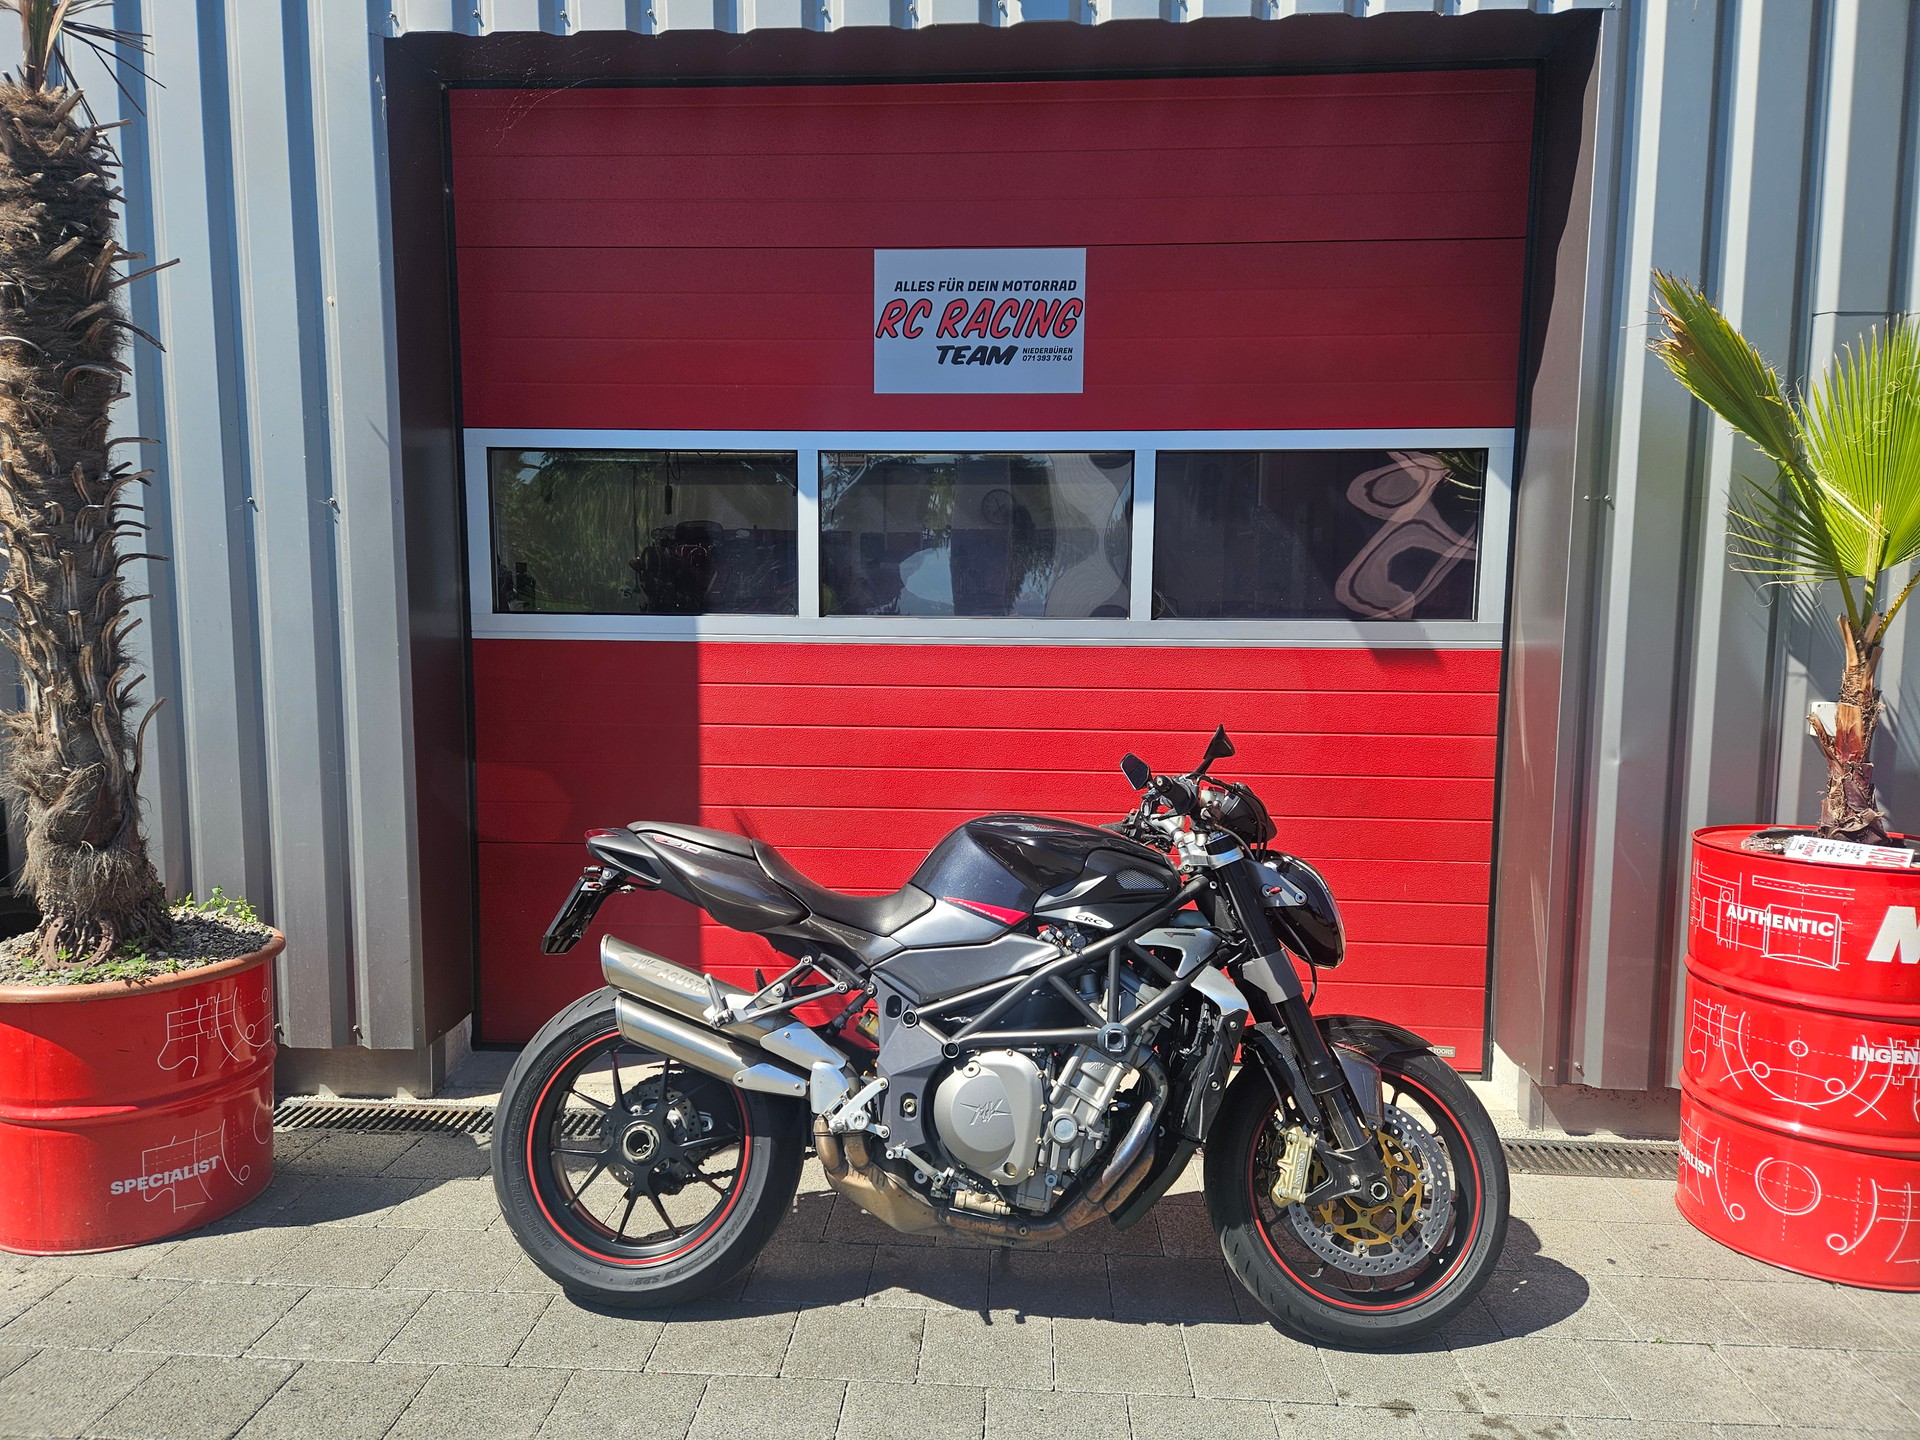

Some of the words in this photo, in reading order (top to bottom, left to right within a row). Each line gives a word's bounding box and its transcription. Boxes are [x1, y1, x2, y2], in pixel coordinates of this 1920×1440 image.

[894, 280, 935, 292] ALLES
[938, 277, 964, 292] FÜR
[967, 280, 999, 292] DEIN
[1002, 280, 1077, 292] MOTORRAD
[875, 297, 933, 339] RC
[935, 297, 1084, 339] RACING
[936, 345, 1019, 366] TEAM
[1022, 346, 1074, 354] NIEDERBÜREN
[1022, 355, 1036, 363] 071
[1036, 355, 1051, 363] 393
[1052, 355, 1062, 363] 76
[1062, 355, 1073, 363] 40
[1075, 914, 1104, 925] CRC
[1725, 903, 1835, 937] AUTHENTIC
[1851, 1045, 1920, 1065] INGEN
[110, 1155, 220, 1195] SPECIALIST
